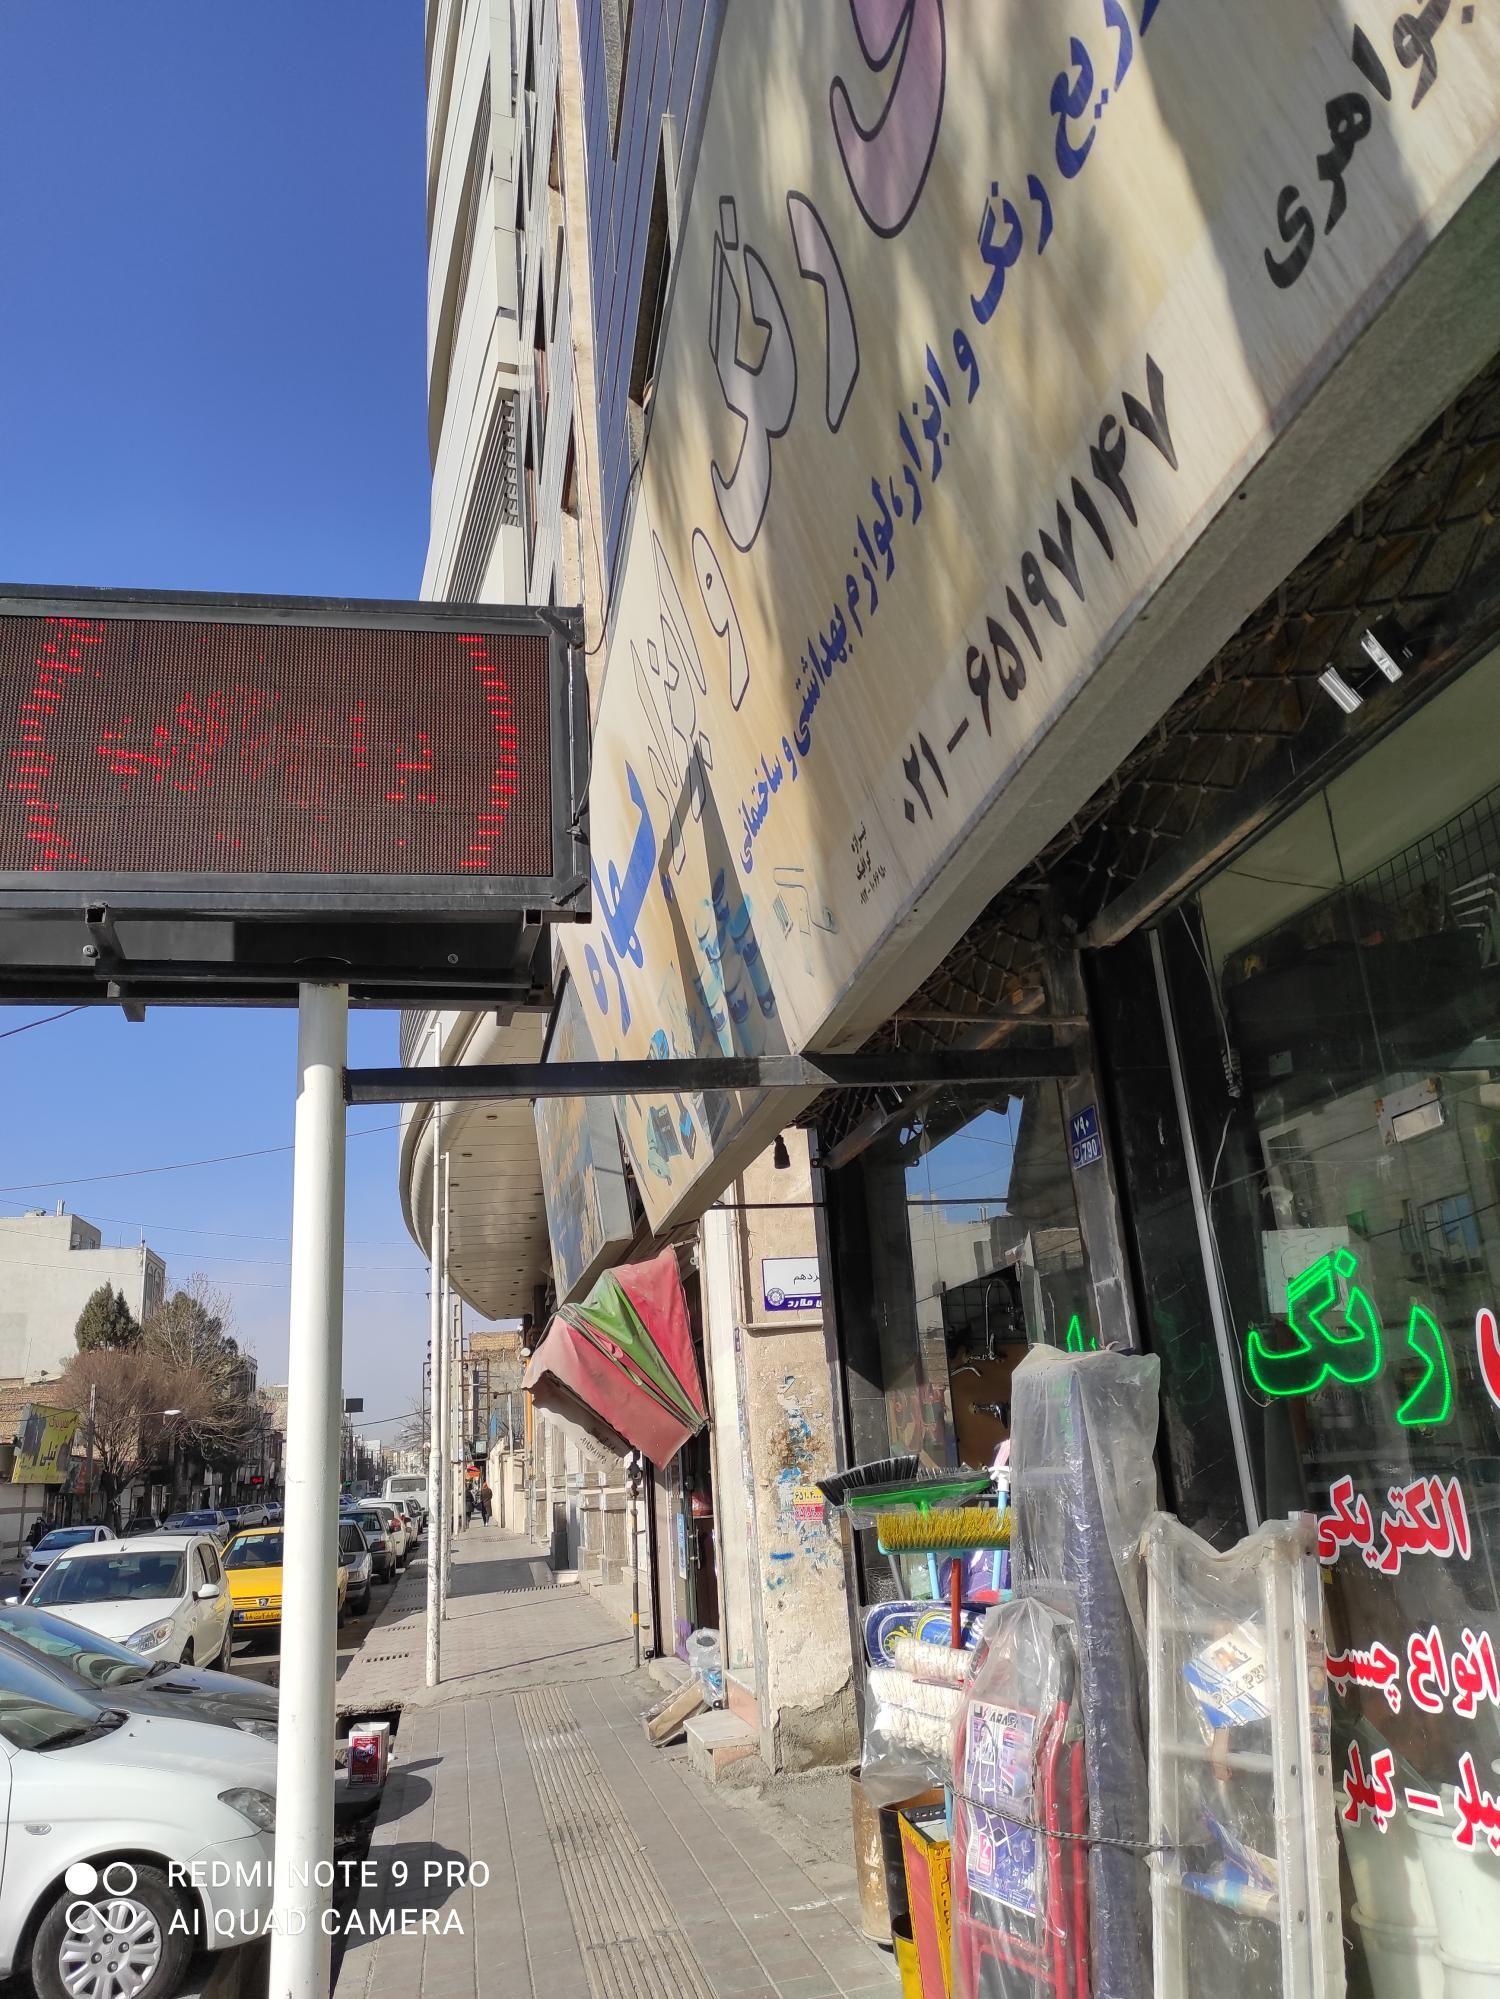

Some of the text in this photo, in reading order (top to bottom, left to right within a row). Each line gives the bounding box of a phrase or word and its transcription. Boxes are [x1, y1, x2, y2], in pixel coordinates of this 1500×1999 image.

[1264, 0, 1475, 290] واهری
[970, 174, 1053, 325] رنگ
[953, 329, 980, 404] و
[630, 189, 860, 877] رنگ و ابزار
[845, 475, 896, 638] لوازم
[793, 602, 854, 757] بهداشتی
[781, 735, 798, 782] و
[739, 752, 784, 875] ساختمانی
[1073, 1115, 1090, 1139] ۷۹۰
[1081, 1138, 1098, 1161] 790
[787, 1298, 813, 1308] ملارد
[1247, 1247, 1452, 1425] رنگ
[1318, 1475, 1471, 1575] الکتریکی
[1407, 1625, 1500, 1719] انواع
[1452, 1751, 1500, 1856] یلر
